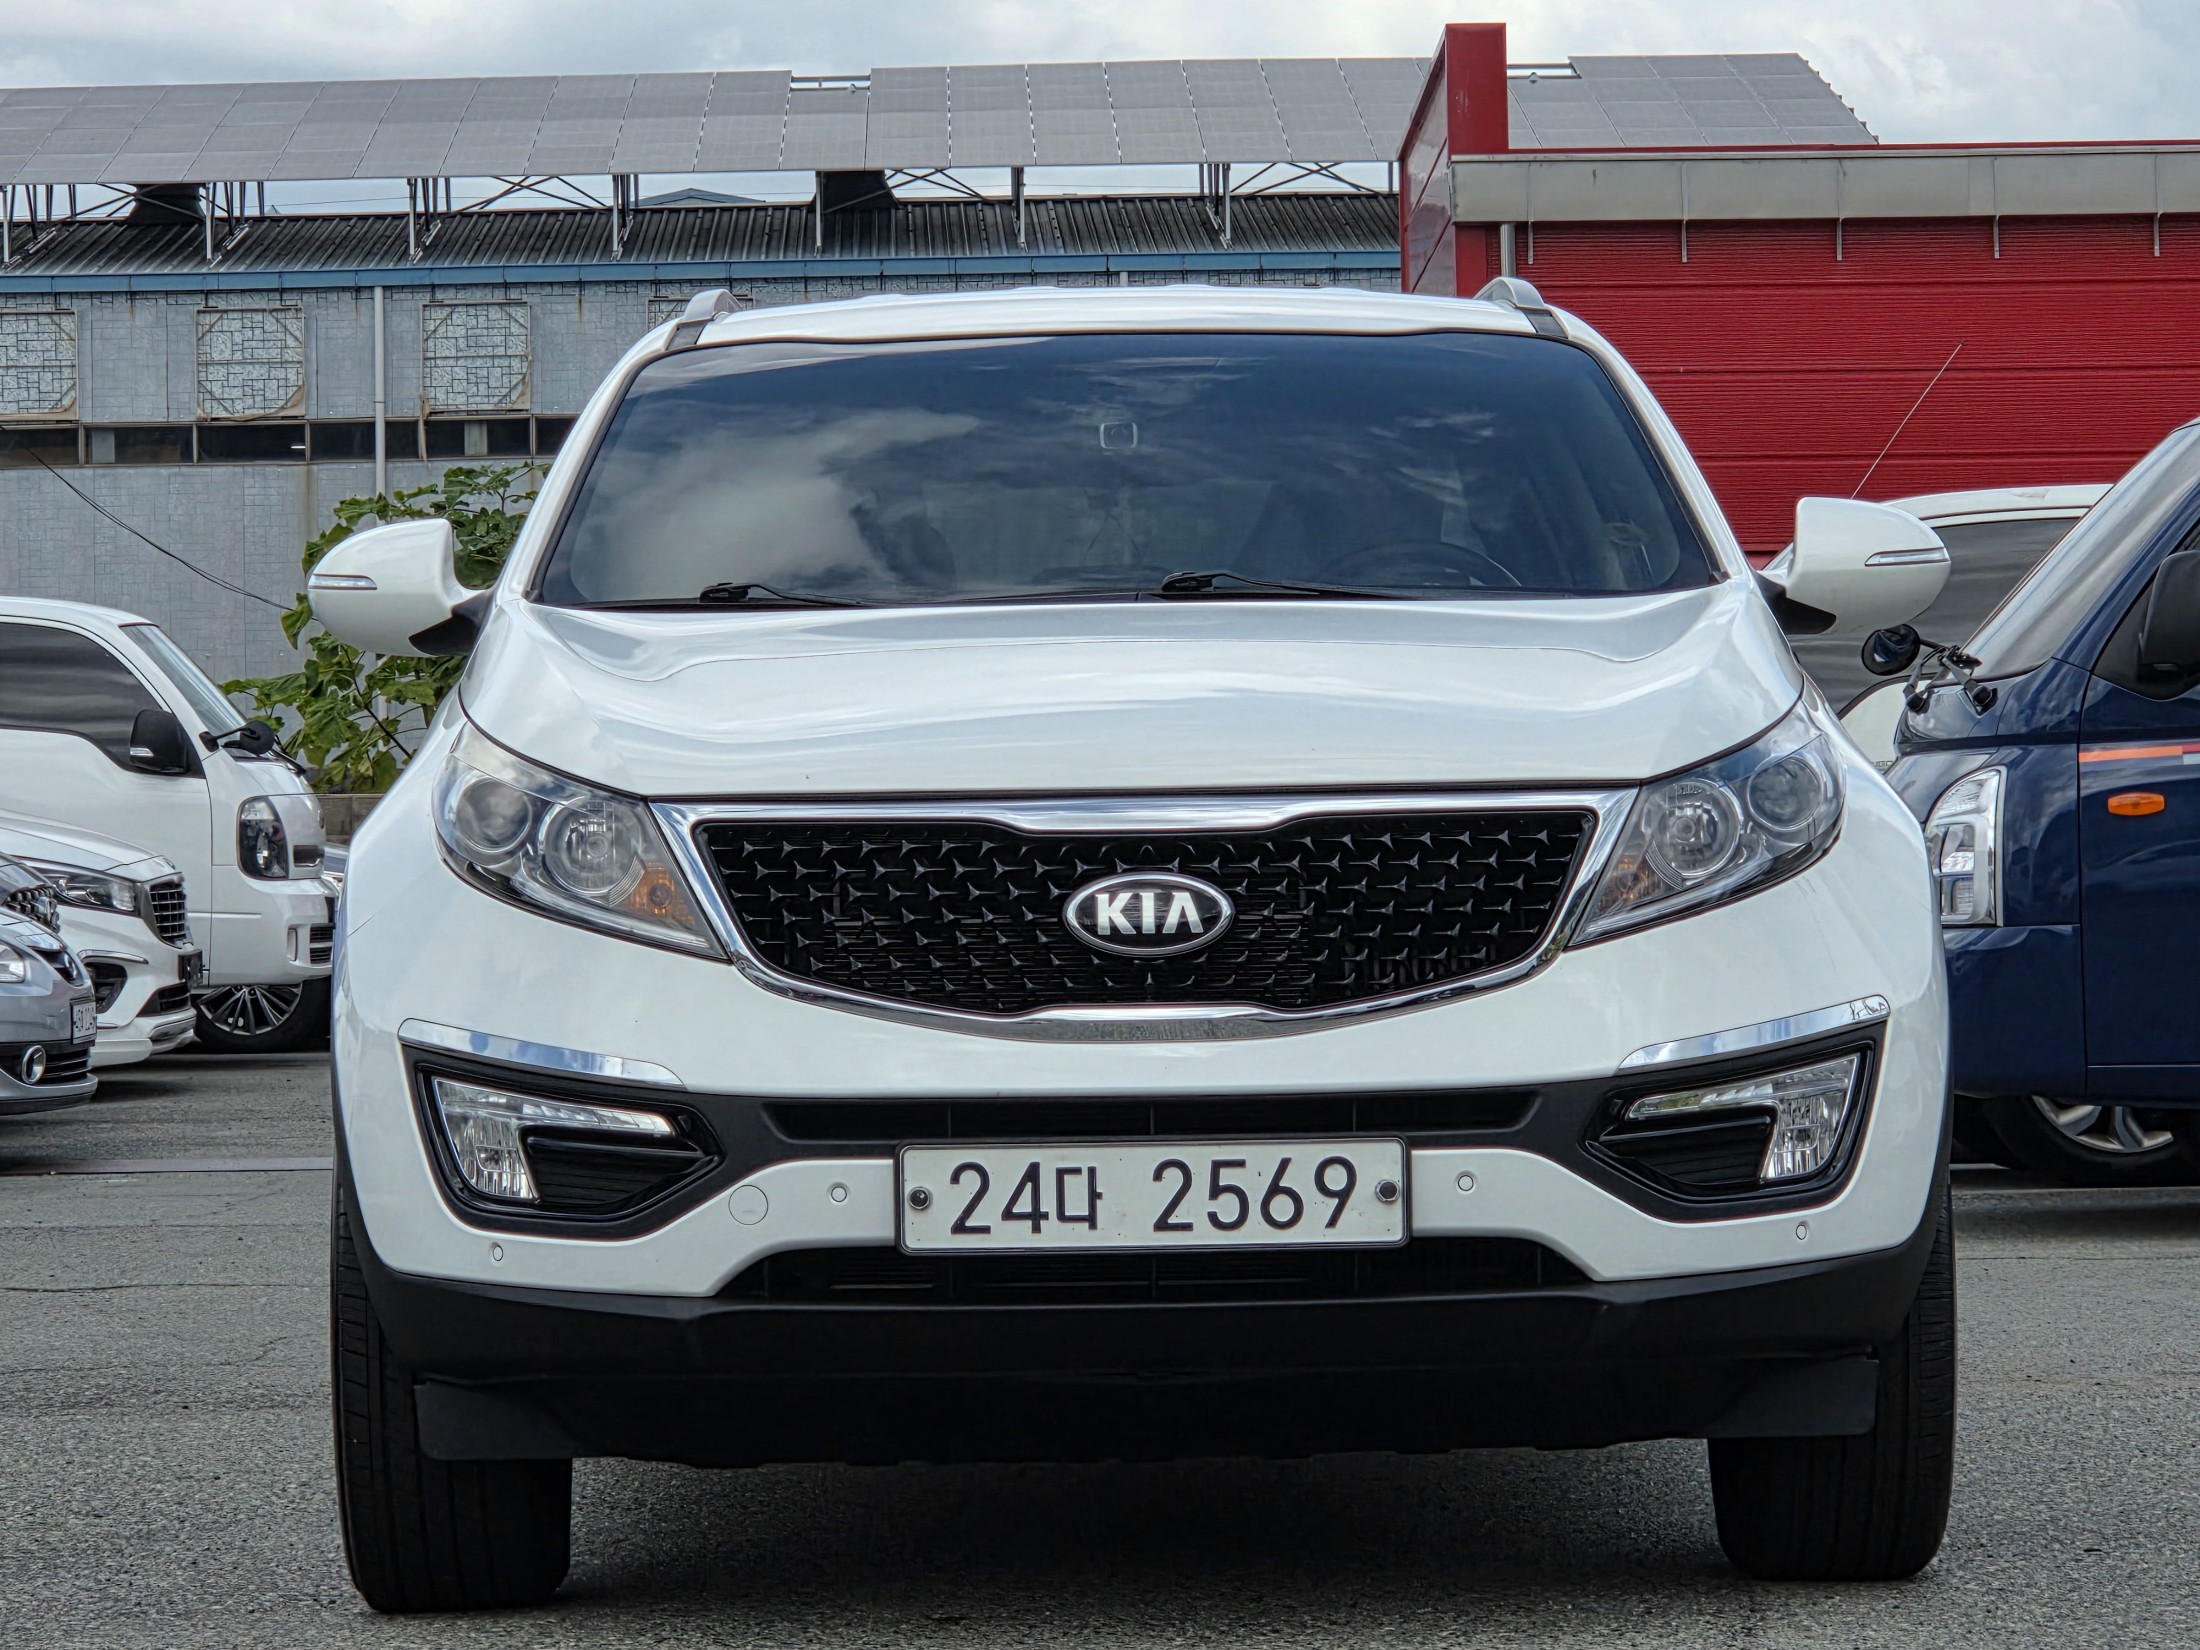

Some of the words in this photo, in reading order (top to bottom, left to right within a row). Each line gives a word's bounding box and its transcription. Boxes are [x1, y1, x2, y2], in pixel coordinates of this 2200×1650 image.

[1095, 891, 1204, 936] KIA
[949, 1161, 1103, 1235] 24다
[1152, 1155, 1358, 1232] 2569
